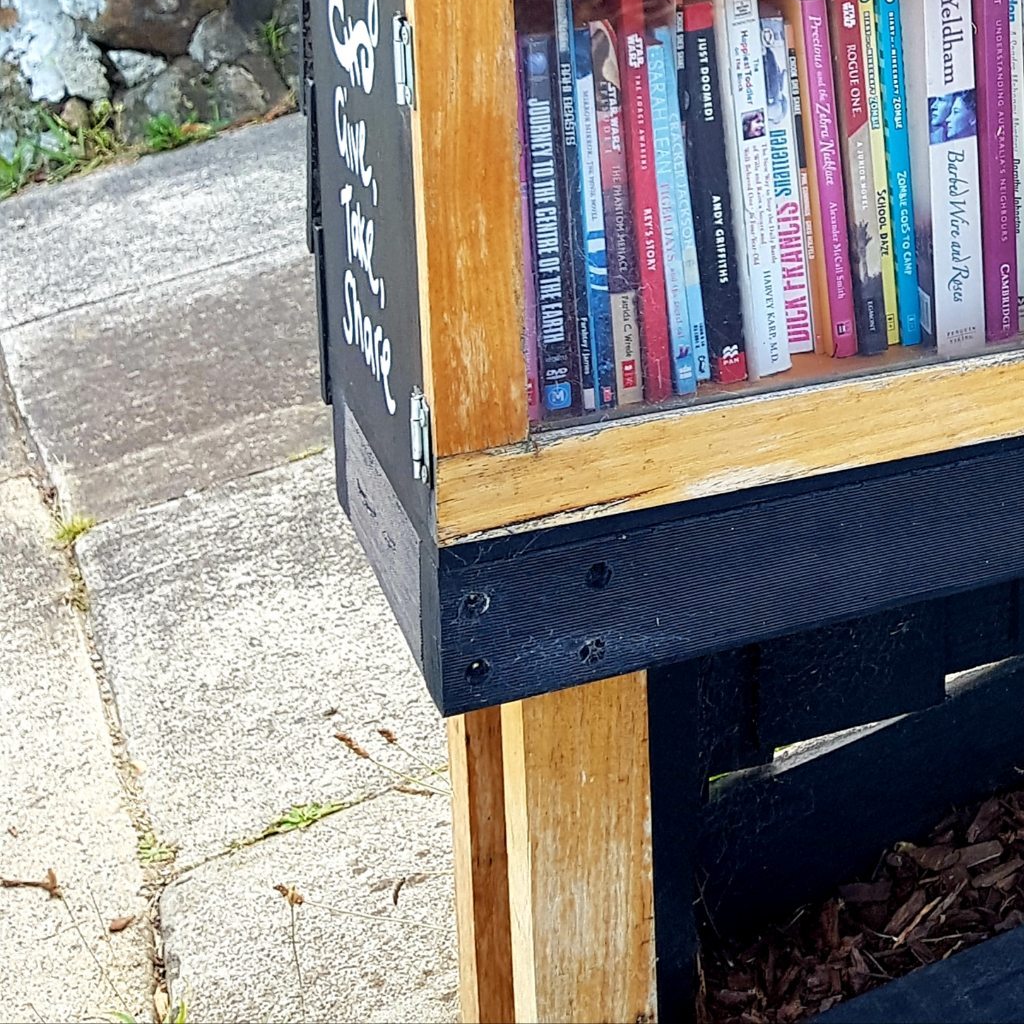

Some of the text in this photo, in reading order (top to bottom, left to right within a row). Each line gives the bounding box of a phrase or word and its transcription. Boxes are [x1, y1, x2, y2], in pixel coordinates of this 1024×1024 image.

[627, 33, 639, 68] WARS
[636, 36, 644, 66] STAR
[697, 38, 714, 121] JUST DOOMED!
[739, 30, 751, 70] Happiest
[846, 44, 860, 86] ROGUE
[863, 11, 880, 130] DIARY MINECRAFT ZOMBIE
[888, 12, 903, 130] DIARY MINECRAFT ZOMBIE
[995, 19, 1004, 106] UNDERSTANDING
[607, 82, 621, 152] STAR WARS
[636, 95, 644, 125] FORCE
[649, 61, 671, 174] SARAH LEAN
[744, 71, 754, 105] Toddler
[808, 15, 836, 186] Precious and the Zebra Necklace
[334, 86, 380, 206] Give,
[527, 98, 552, 156] JOURNEY
[639, 129, 648, 170] AWAKENS
[997, 111, 1007, 174] AUSTRALIA'S
[532, 161, 554, 177] TO
[533, 179, 556, 204] THE
[669, 113, 693, 250] CRACKER JACKSON
[857, 152, 867, 183] JUNIOR
[860, 183, 868, 210] NOVEL
[535, 206, 562, 254] CENTRE
[612, 166, 628, 272] THE PHANTOM MENACE
[643, 208, 656, 271] REY'S STORY
[712, 195, 729, 283] ANDY GRIFFITHS
[877, 191, 889, 256] SCHOOL DAZE
[897, 172, 912, 275] ZOMBIE GOES TO CAMP
[947, 149, 971, 302] Barbed Wire and Roses
[999, 178, 1008, 242] NEIGHBOURS
[339, 183, 386, 309] Take,
[539, 257, 562, 273] OF
[663, 227, 676, 263] DAYS
[775, 202, 810, 343] DICK FRANCIS
[829, 202, 846, 299] Alexander McCall Smith
[540, 275, 563, 302] THE
[762, 270, 773, 309] HARVEY
[770, 342, 779, 363] M.D.
[867, 301, 876, 332] EGMONT
[1000, 264, 1011, 330] CAMBRIDGE
[342, 268, 396, 416] Share
[542, 303, 565, 344] EARTH
[625, 334, 633, 357] Wrede
[722, 357, 740, 367] PAN
